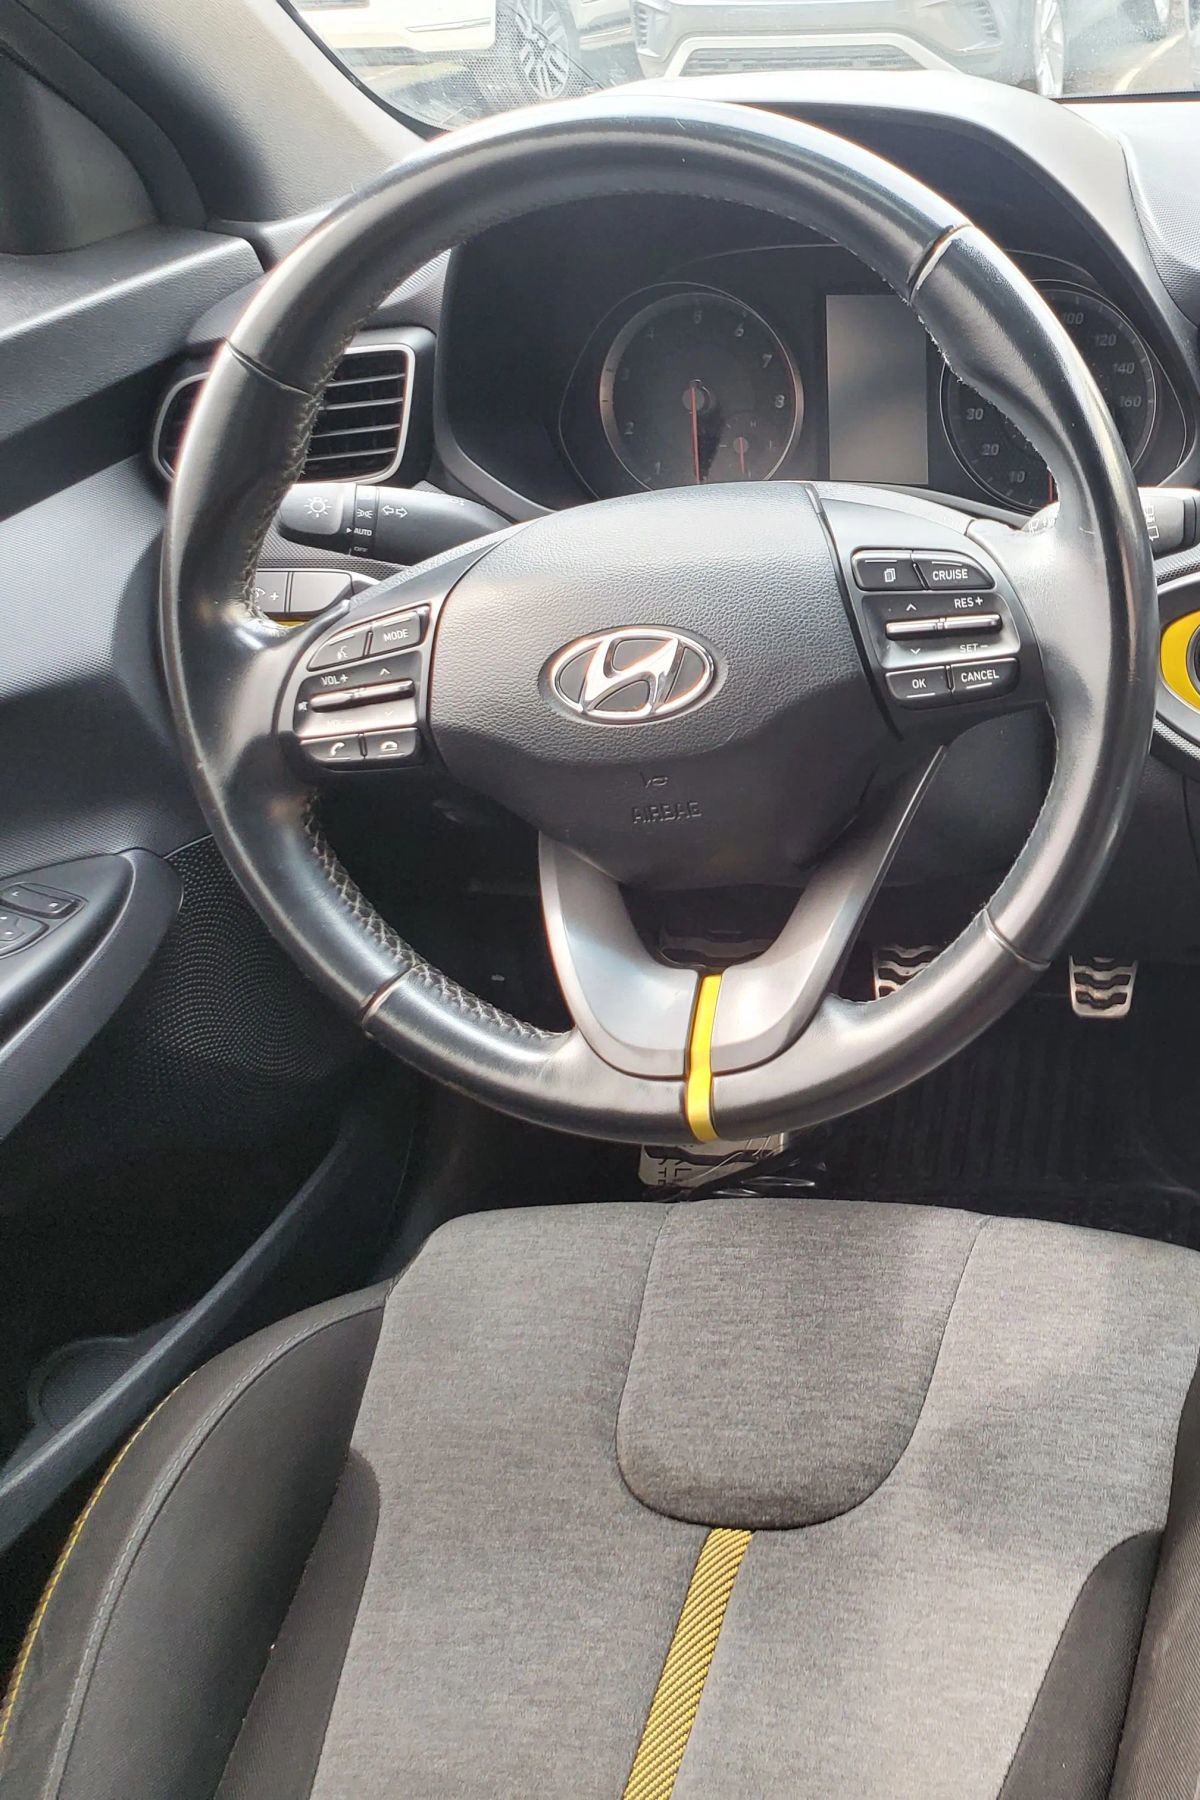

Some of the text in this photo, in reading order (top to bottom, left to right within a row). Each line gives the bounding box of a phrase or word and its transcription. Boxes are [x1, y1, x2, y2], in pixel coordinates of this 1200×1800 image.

[762, 354, 773, 368] 7
[353, 527, 373, 537] AUTO
[932, 568, 968, 581] CRUISE
[383, 628, 409, 642] MODE
[961, 669, 1000, 682] CANCEL
[912, 678, 927, 689] OK
